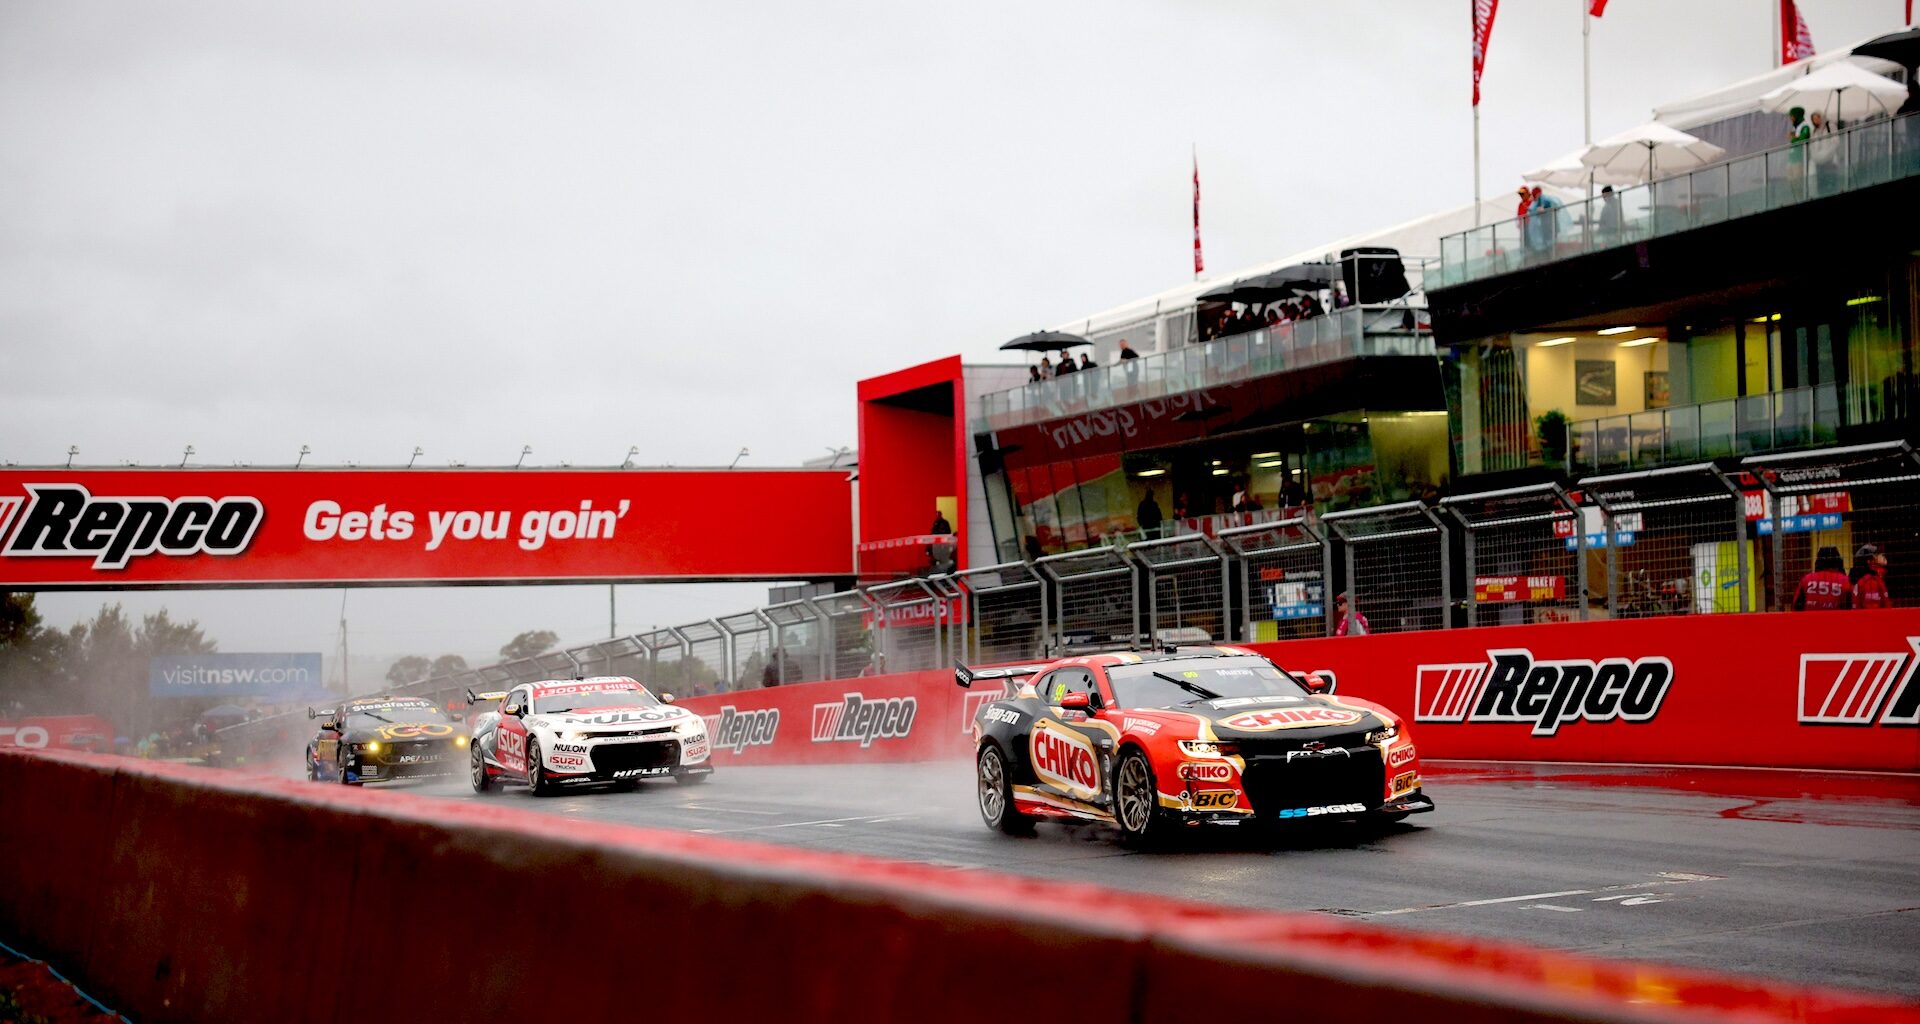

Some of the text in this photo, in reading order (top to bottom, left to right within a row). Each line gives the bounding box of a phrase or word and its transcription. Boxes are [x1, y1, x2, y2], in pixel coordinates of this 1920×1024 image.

[3, 483, 264, 570] Repco
[304, 500, 630, 551] Gets you goin'
[1807, 580, 1842, 597] 255
[163, 664, 309, 685] visitnsw.com
[538, 686, 577, 698] 1300
[580, 684, 603, 692] WE
[1468, 648, 1674, 736] Repco
[352, 701, 416, 712] Steadfast
[566, 708, 682, 725] NULON
[836, 692, 917, 748] Repco
[1227, 708, 1350, 729] CHIKO
[717, 705, 780, 754] Repco
[683, 733, 705, 745] NULON
[553, 743, 588, 754] NULON
[686, 747, 707, 757] ISUZU
[1391, 747, 1414, 764] CHIKO
[550, 756, 584, 766] ISUZU
[1034, 730, 1096, 790] CHIKO
[613, 766, 670, 778] HIFLEX
[1180, 765, 1229, 779] CHIKO
